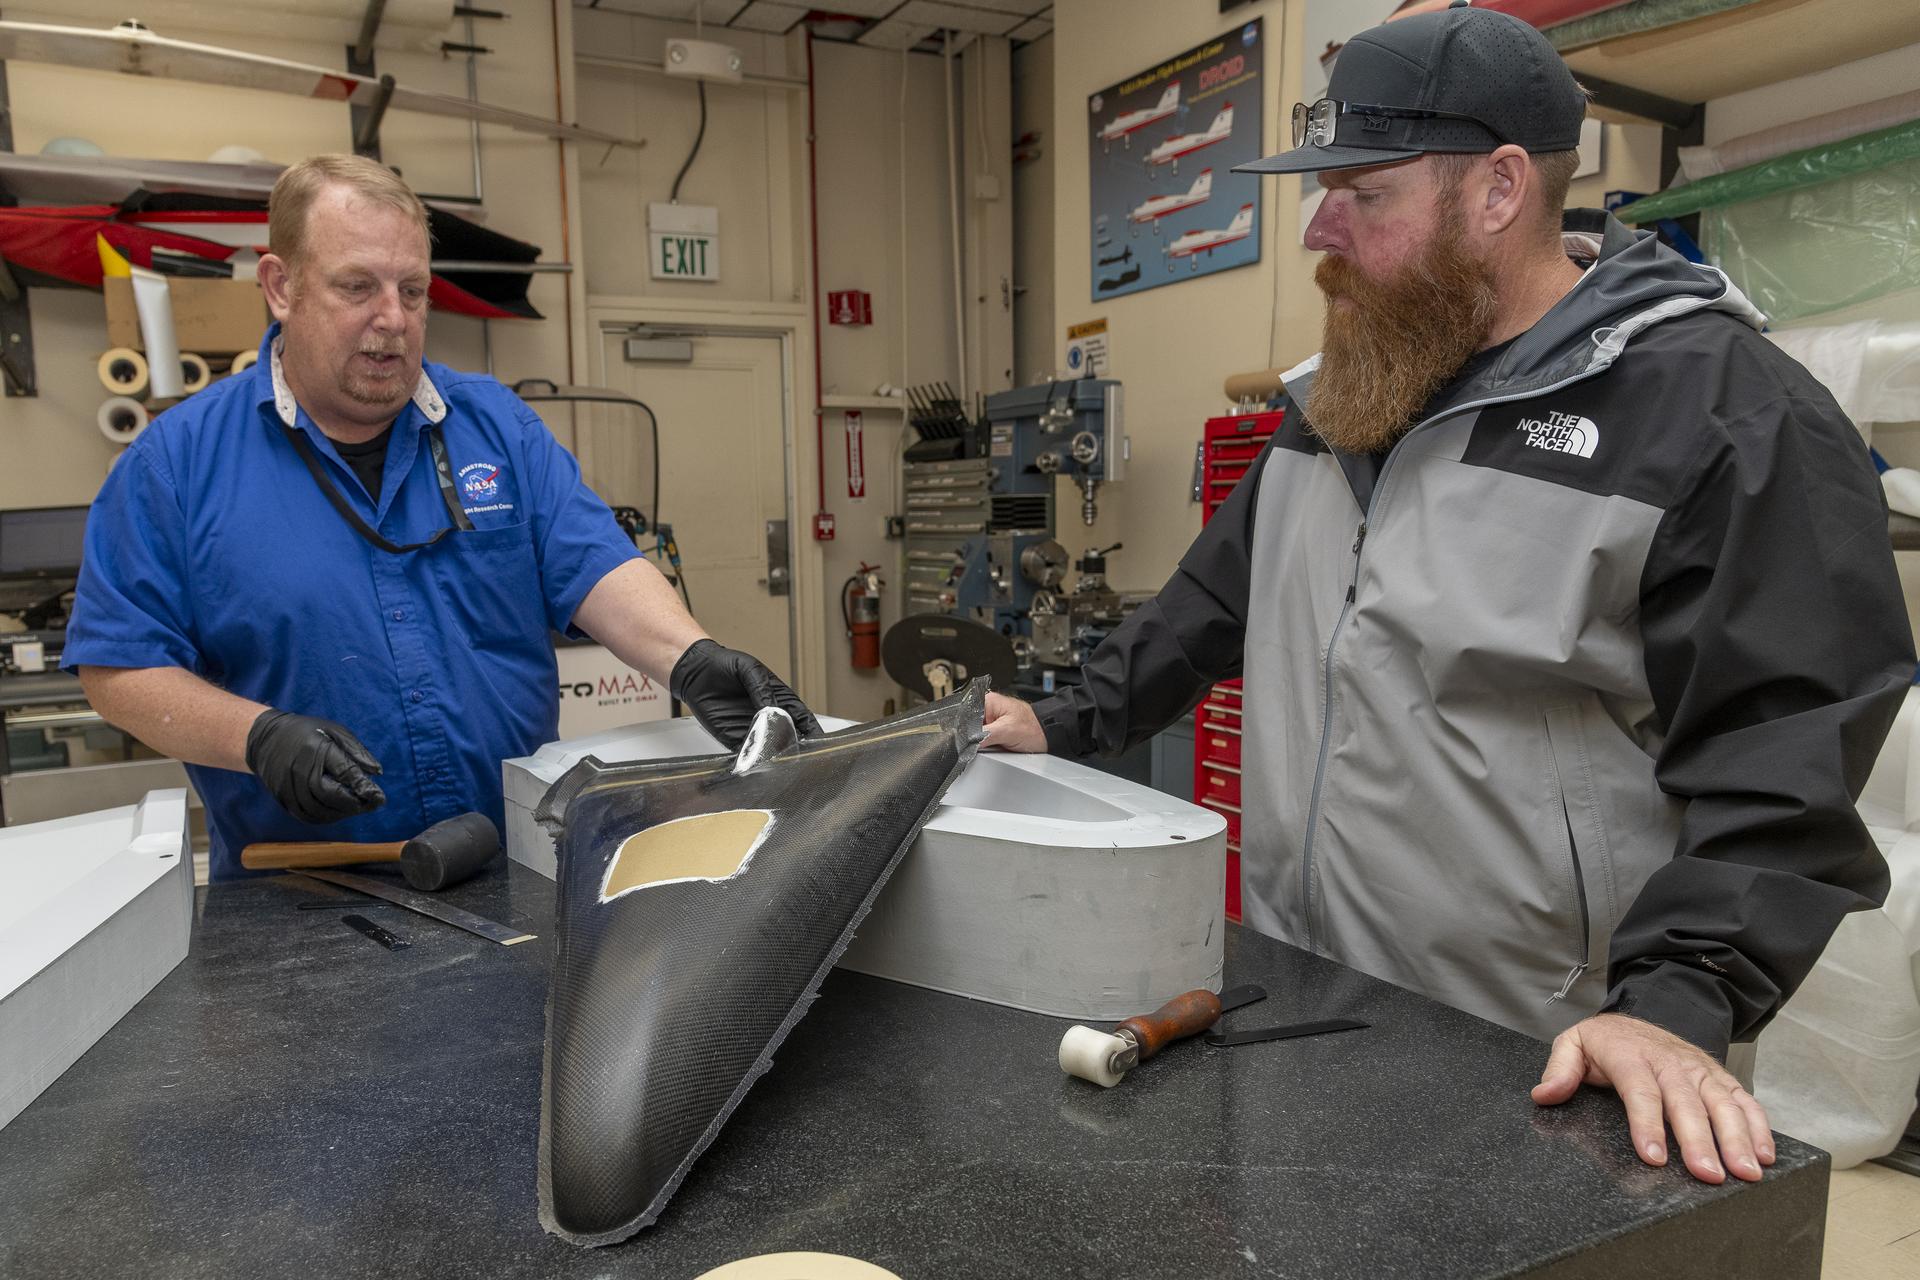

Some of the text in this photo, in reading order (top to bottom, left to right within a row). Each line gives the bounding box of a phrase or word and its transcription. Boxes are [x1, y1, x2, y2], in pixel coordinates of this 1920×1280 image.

[1199, 55, 1244, 88] DROID
[661, 237, 709, 276] EXIT
[1549, 410, 1580, 428] THE
[1516, 418, 1574, 440] NORTH
[1525, 433, 1566, 452] FACE
[458, 463, 497, 478] ARMSTRONG
[465, 480, 497, 491] NASA
[474, 504, 498, 512] Research
[598, 698, 619, 707] BUILT
[635, 694, 658, 702] OMAX
[1696, 953, 1728, 973] VENT
